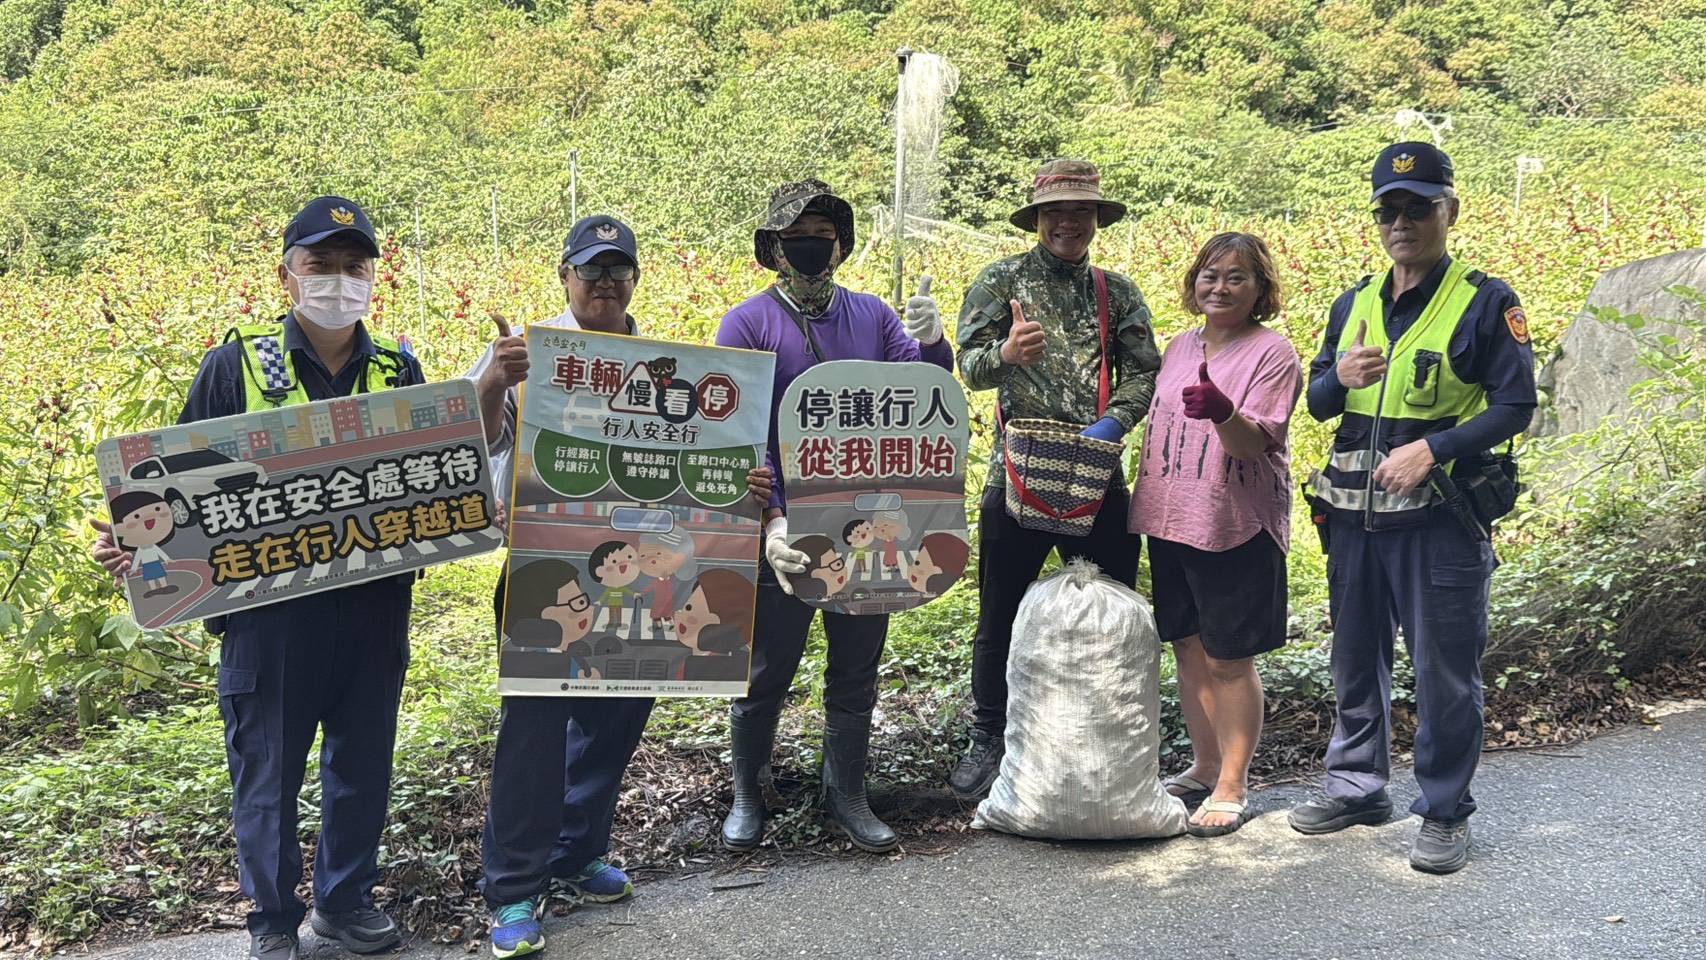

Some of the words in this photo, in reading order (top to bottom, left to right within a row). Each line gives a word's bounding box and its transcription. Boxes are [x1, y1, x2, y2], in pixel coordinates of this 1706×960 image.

[796, 387, 955, 429] 停讓行人
[602, 417, 699, 444] 行人安全行
[555, 446, 601, 460] 行經路口
[622, 451, 676, 466] 無號誌路口
[797, 435, 955, 478] 從我開始
[554, 460, 600, 474] 停讓行人
[687, 454, 750, 469] 至路口中心點
[626, 465, 670, 480] 遵守停讓
[702, 468, 733, 482] 再轉彎
[200, 447, 479, 535] 我在安全處等待
[695, 481, 738, 495] 避免死角
[212, 495, 488, 583] 走在行人穿越道
